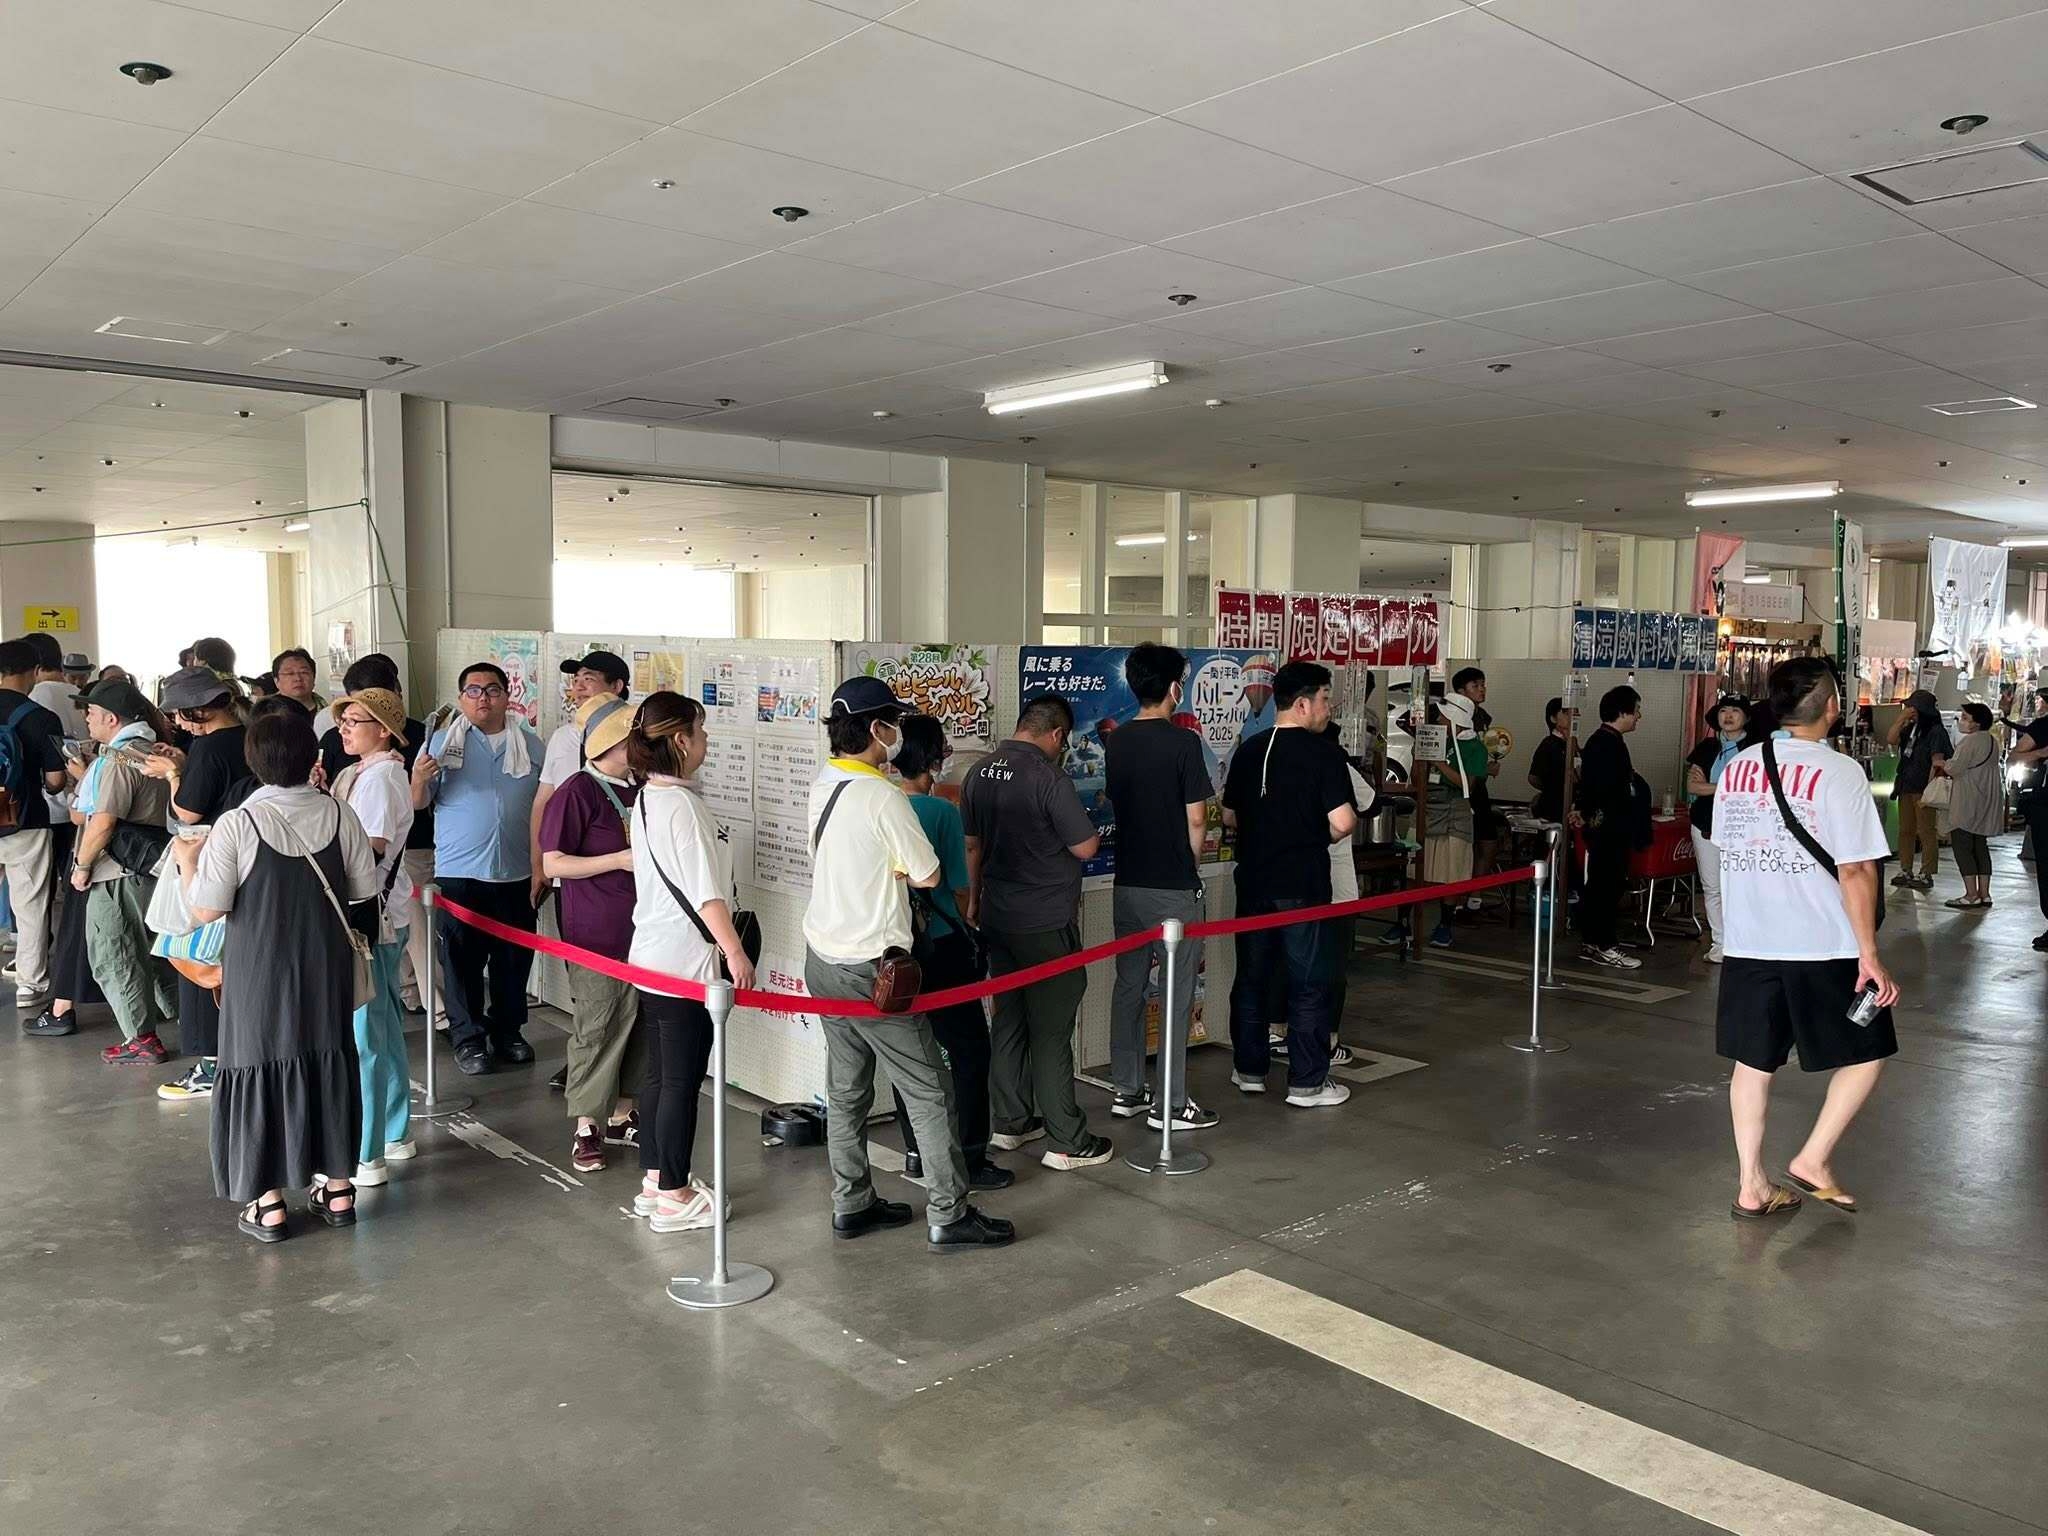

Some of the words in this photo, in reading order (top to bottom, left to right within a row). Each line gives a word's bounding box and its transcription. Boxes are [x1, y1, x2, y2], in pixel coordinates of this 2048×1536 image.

[38, 619, 66, 629] 出口
[1219, 610, 1439, 656] 時間限定ビール
[910, 652, 942, 664] 第28回
[1023, 656, 1073, 673] 風に乗る
[877, 664, 897, 678] 全国
[1022, 675, 1107, 693] レースも好きだ。
[1196, 680, 1248, 706] バルーン
[1195, 707, 1248, 725] フェスティバル
[1209, 726, 1233, 742] 2025
[980, 767, 1014, 781] CREW
[1761, 848, 1787, 862] NOT
[1795, 851, 1805, 862] A
[1759, 857, 1818, 874] CONCERT
[769, 969, 804, 993] 足元注意
